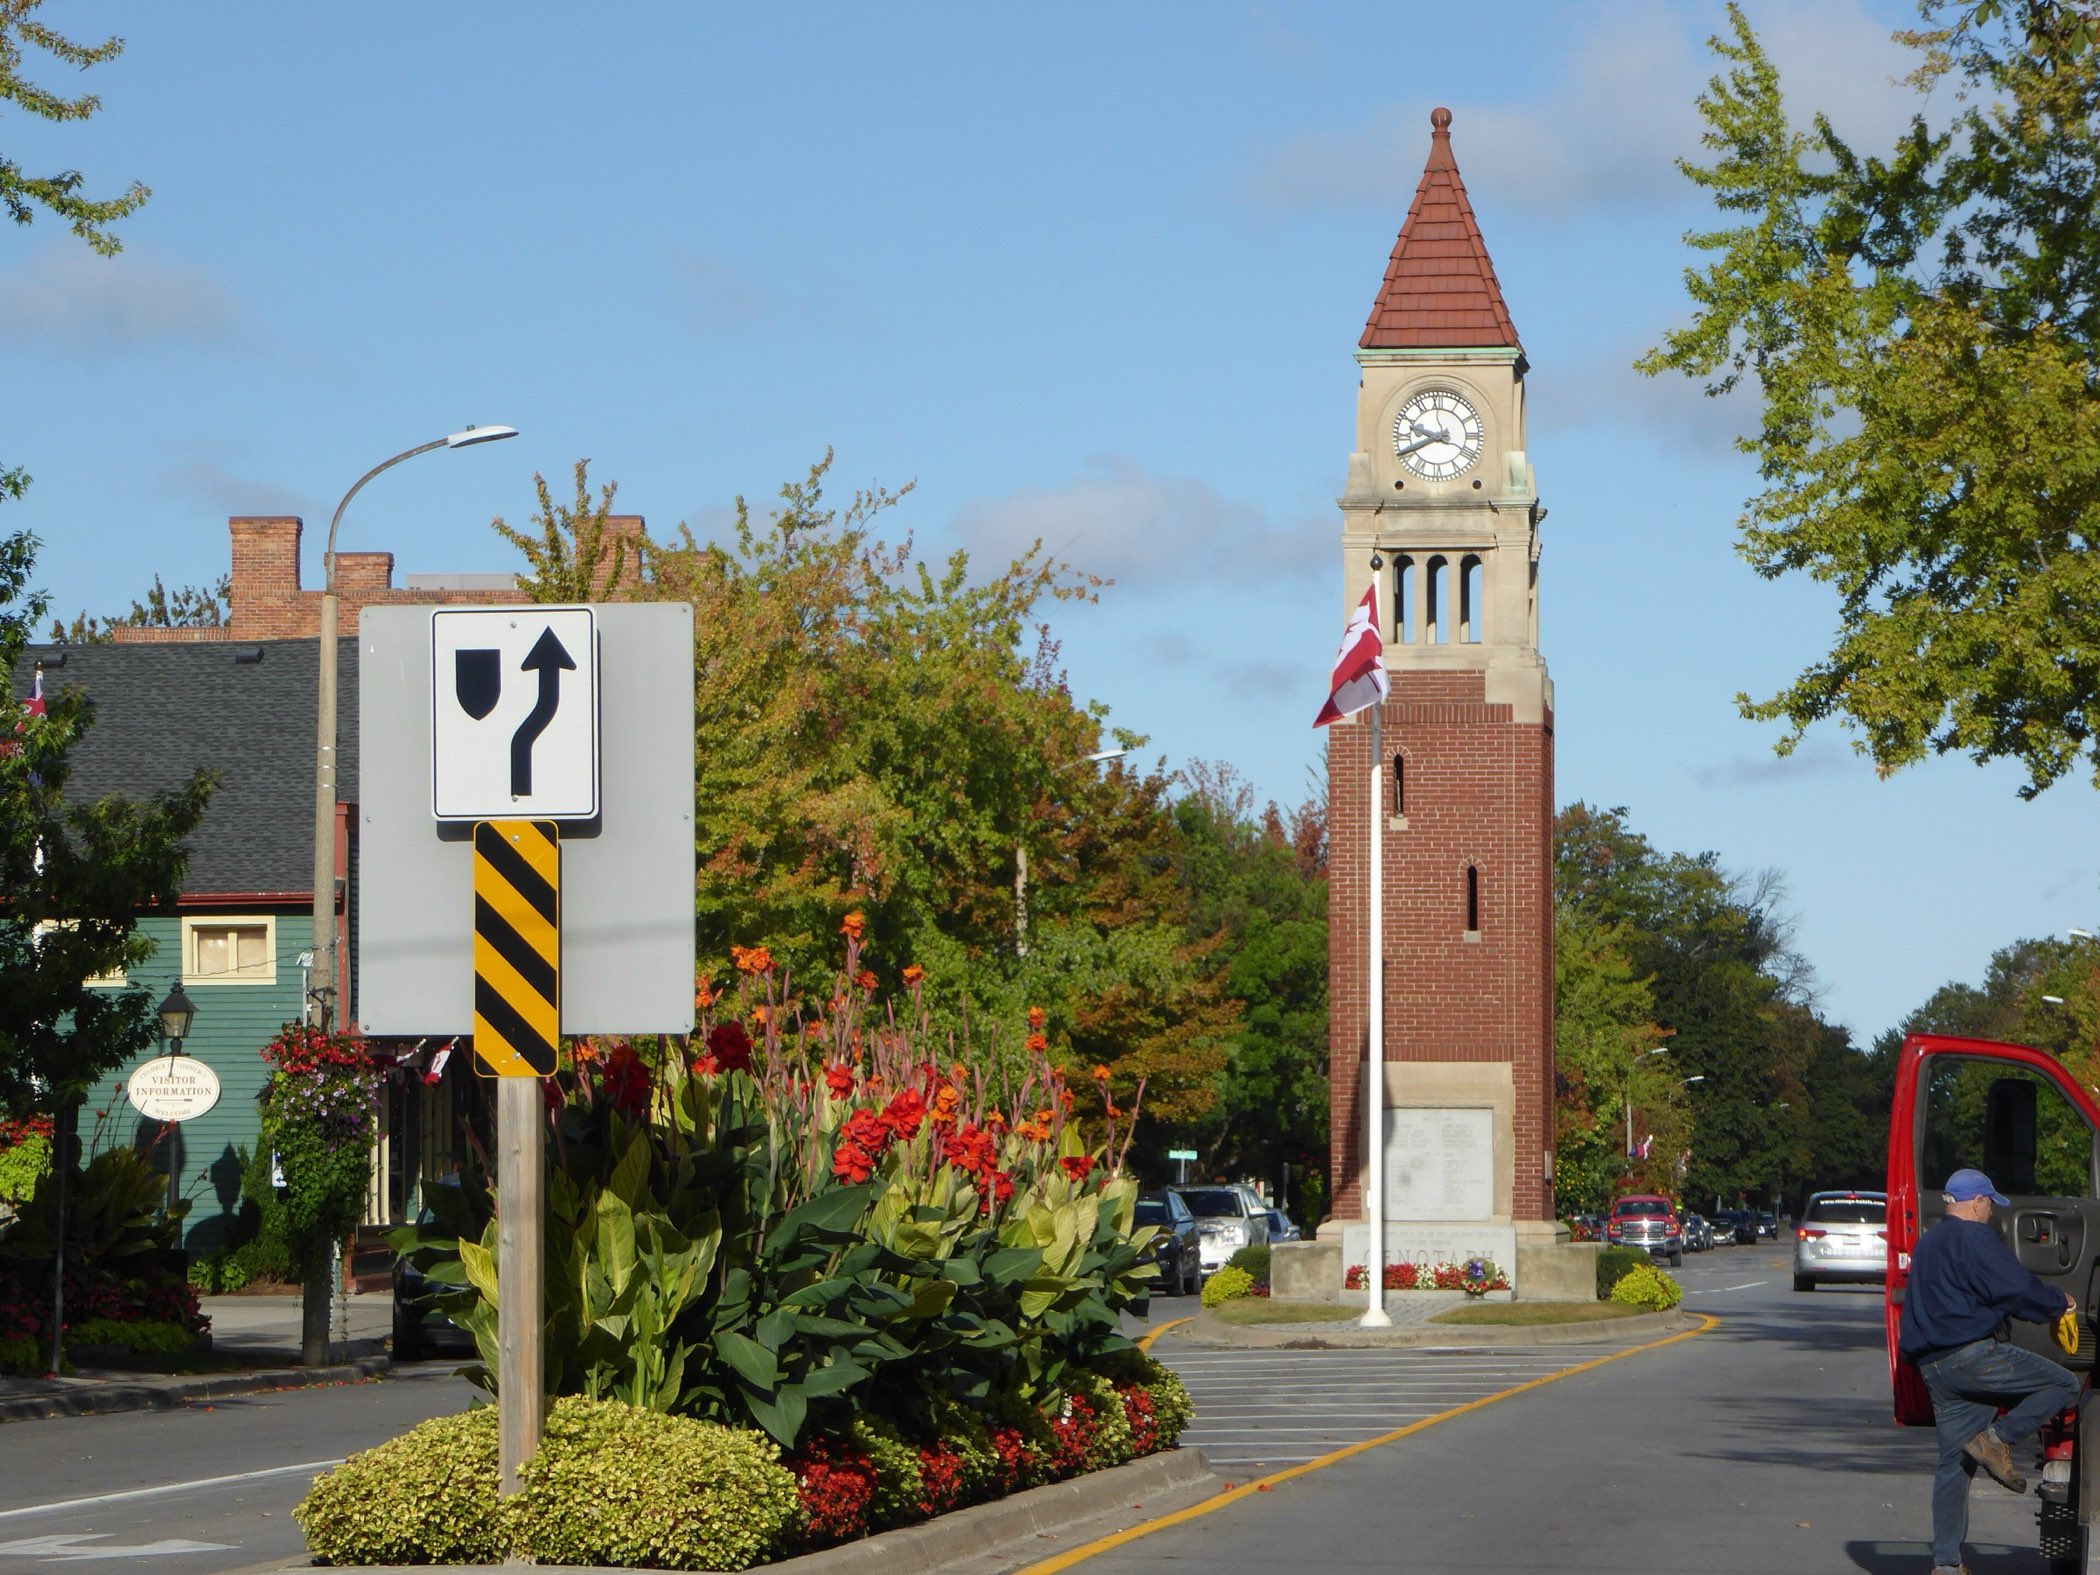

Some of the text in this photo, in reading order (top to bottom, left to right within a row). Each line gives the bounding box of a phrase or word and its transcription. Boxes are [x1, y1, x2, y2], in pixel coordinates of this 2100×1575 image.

[152, 1076, 196, 1085] VISITOR
[136, 1087, 212, 1096] INFORMATION
[154, 1108, 191, 1117] WELCOME
